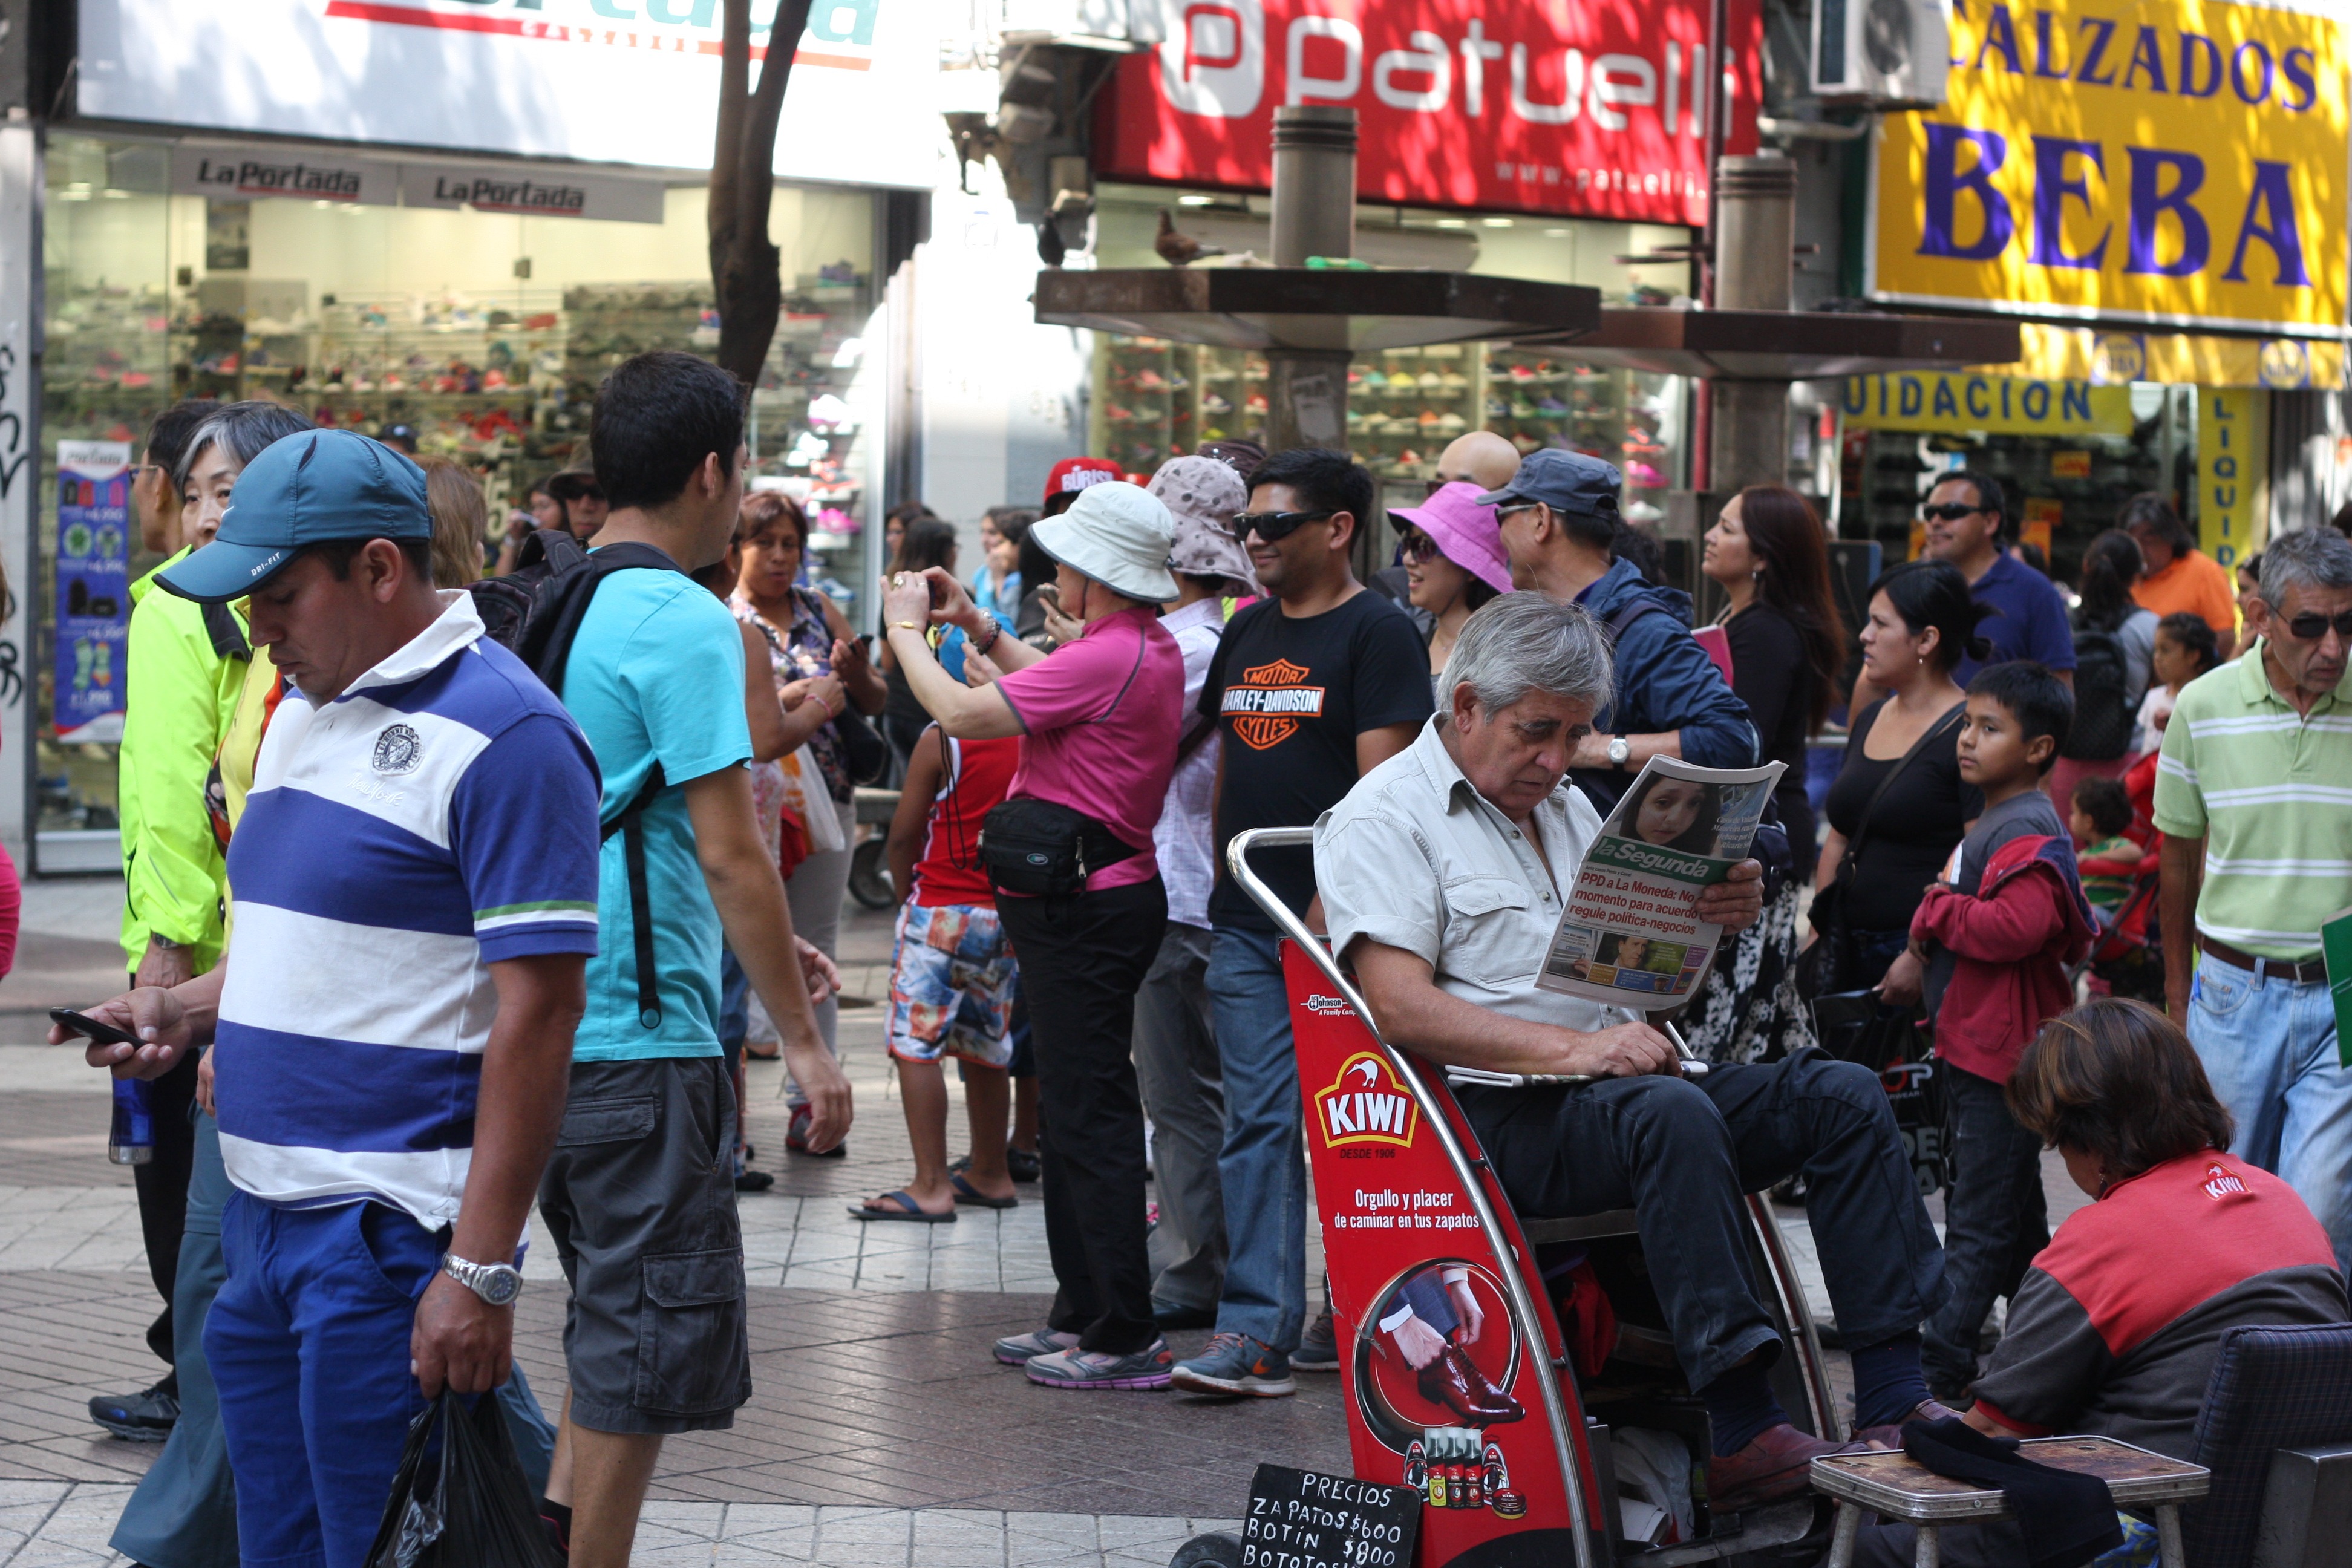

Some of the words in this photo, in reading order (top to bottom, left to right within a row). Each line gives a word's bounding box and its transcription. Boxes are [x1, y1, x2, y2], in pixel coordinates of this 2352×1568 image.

[1949, 0, 2316, 112] ALZADOS
[1286, 16, 1735, 140] patuelli
[1916, 121, 2313, 287] BEBA
[251, 552, 280, 577] DRI-FIT
[1249, 664, 1299, 685] MOTOR
[1221, 689, 1322, 713] HARLEY-DAVIDSON
[1238, 717, 1290, 745] CYCLES
[1593, 838, 1613, 856] la
[1614, 843, 1710, 878] Segunda
[1580, 872, 1606, 887] PPD
[1606, 880, 1613, 889] a
[1615, 879, 1628, 892] La
[1631, 882, 1677, 900] Moneda:
[1679, 890, 1695, 903] No
[1575, 890, 1627, 907] momento
[1628, 900, 1653, 913] para
[1655, 903, 1698, 920] acuerdo
[1569, 904, 1606, 920] regule
[1607, 909, 1696, 935] política-negocios
[1309, 996, 1341, 1009] Johnson
[1323, 1008, 1341, 1017] Family
[1327, 1092, 1407, 1136] KIWI
[1339, 1148, 1371, 1159] DESDE
[1375, 1148, 1396, 1158] 1906
[1354, 1189, 1399, 1211] Orgullo
[1403, 1193, 1410, 1211] y
[1413, 1189, 1454, 1211] placer
[2204, 1177, 2246, 1198] KIWI
[1334, 1212, 1347, 1229] de
[1350, 1212, 1395, 1229] caminar
[1397, 1215, 1412, 1229] en
[1414, 1212, 1432, 1229] tus
[1434, 1212, 1481, 1232] zapatos
[1301, 1473, 1393, 1508] PRECIOS
[1350, 1513, 1402, 1543] $600
[1342, 1540, 1396, 1566] $800
